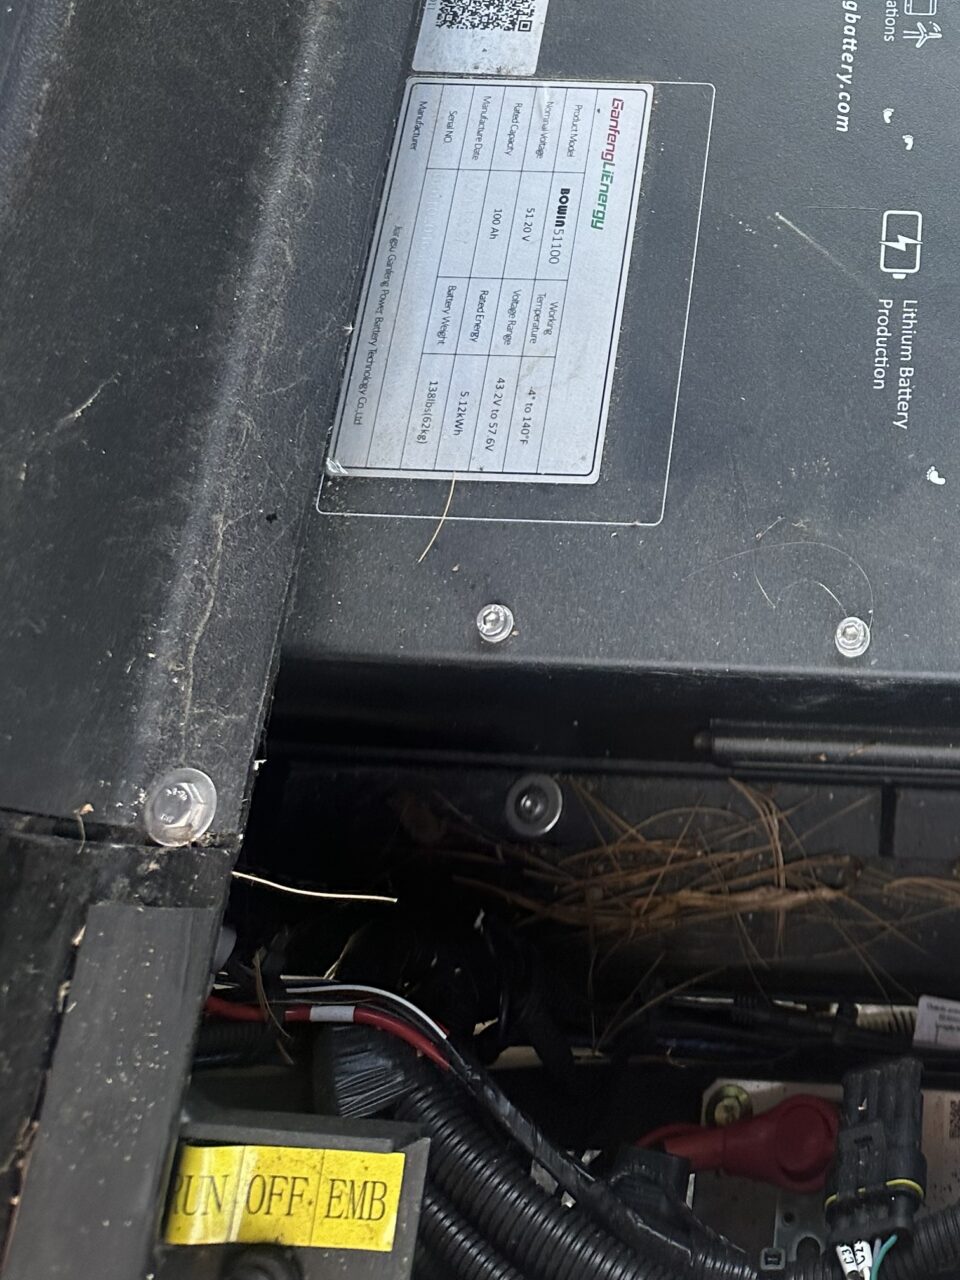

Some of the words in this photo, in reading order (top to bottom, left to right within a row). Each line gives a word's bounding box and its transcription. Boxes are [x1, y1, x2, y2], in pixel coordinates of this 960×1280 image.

[409, 101, 428, 151] Manufacturer
[444, 111, 458, 129] Serial
[475, 96, 492, 142] Manufacture
[511, 103, 523, 123] Rated
[570, 105, 583, 133] Product
[472, 143, 483, 161] Date
[504, 124, 518, 156] Capacity
[535, 132, 548, 159] Voltage
[567, 133, 578, 157] Model
[492, 208, 502, 225] 100
[489, 227, 500, 240] Ah
[375, 290, 389, 315] Power
[442, 285, 457, 314] Battery
[477, 290, 489, 313] Rated
[508, 289, 522, 319] Voltage
[367, 317, 384, 346] Battery
[437, 315, 450, 345] Weight
[469, 315, 483, 342] Energy
[502, 320, 516, 346] Range
[529, 293, 547, 344] Temperature
[543, 302, 559, 335] Working
[900, 300, 918, 361] Lithium
[873, 299, 893, 390] Production
[358, 348, 378, 395] Technology
[492, 378, 505, 406] 43.2V
[892, 367, 914, 430] Battery
[416, 380, 439, 444] 138lbs(62kg)
[453, 391, 470, 436] 5.12kWh
[490, 409, 500, 419] to
[524, 403, 534, 413] to
[484, 422, 498, 452] 57.6V
[245, 1174, 309, 1217] OFF
[325, 1178, 388, 1221] EMB
